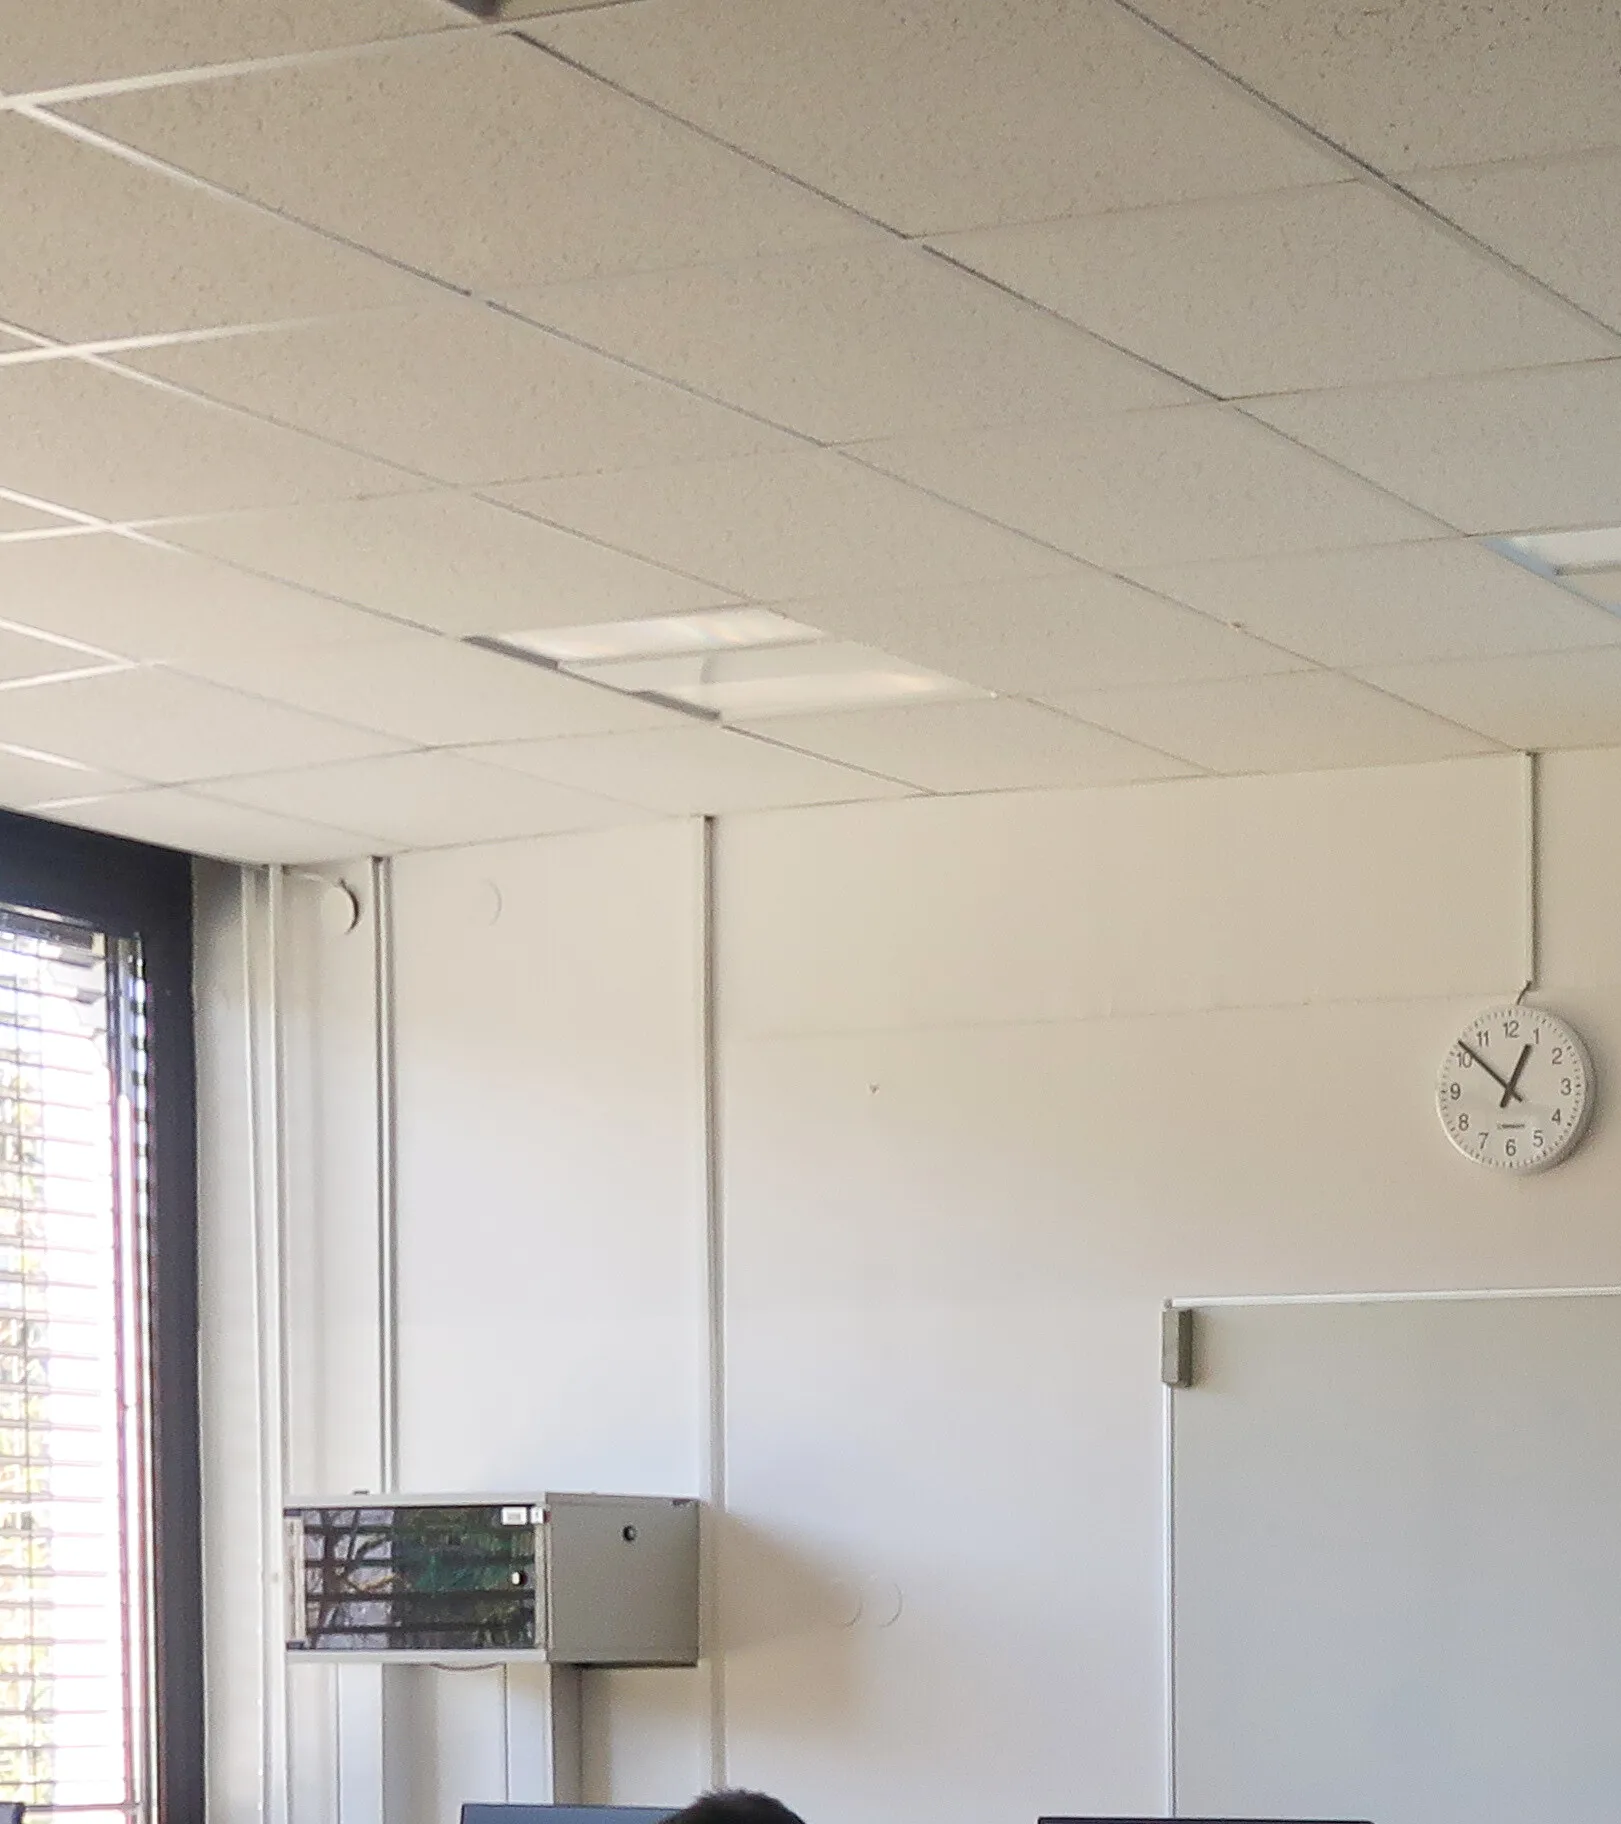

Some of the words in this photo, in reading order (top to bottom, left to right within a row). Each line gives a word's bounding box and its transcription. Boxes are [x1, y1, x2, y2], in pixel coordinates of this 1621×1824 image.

[1476, 1031, 1490, 1047] 11
[1503, 1021, 1520, 1039] 12
[1533, 1028, 1540, 1045] 1
[1457, 1052, 1473, 1069] 10
[1551, 1047, 1563, 1066] 2
[1450, 1083, 1462, 1101] 9
[1560, 1078, 1572, 1096] 3
[1458, 1113, 1470, 1131] 8
[1551, 1108, 1562, 1125] 4
[1478, 1131, 1489, 1150] 7
[1505, 1139, 1517, 1156] 6
[1533, 1130, 1545, 1148] 5
